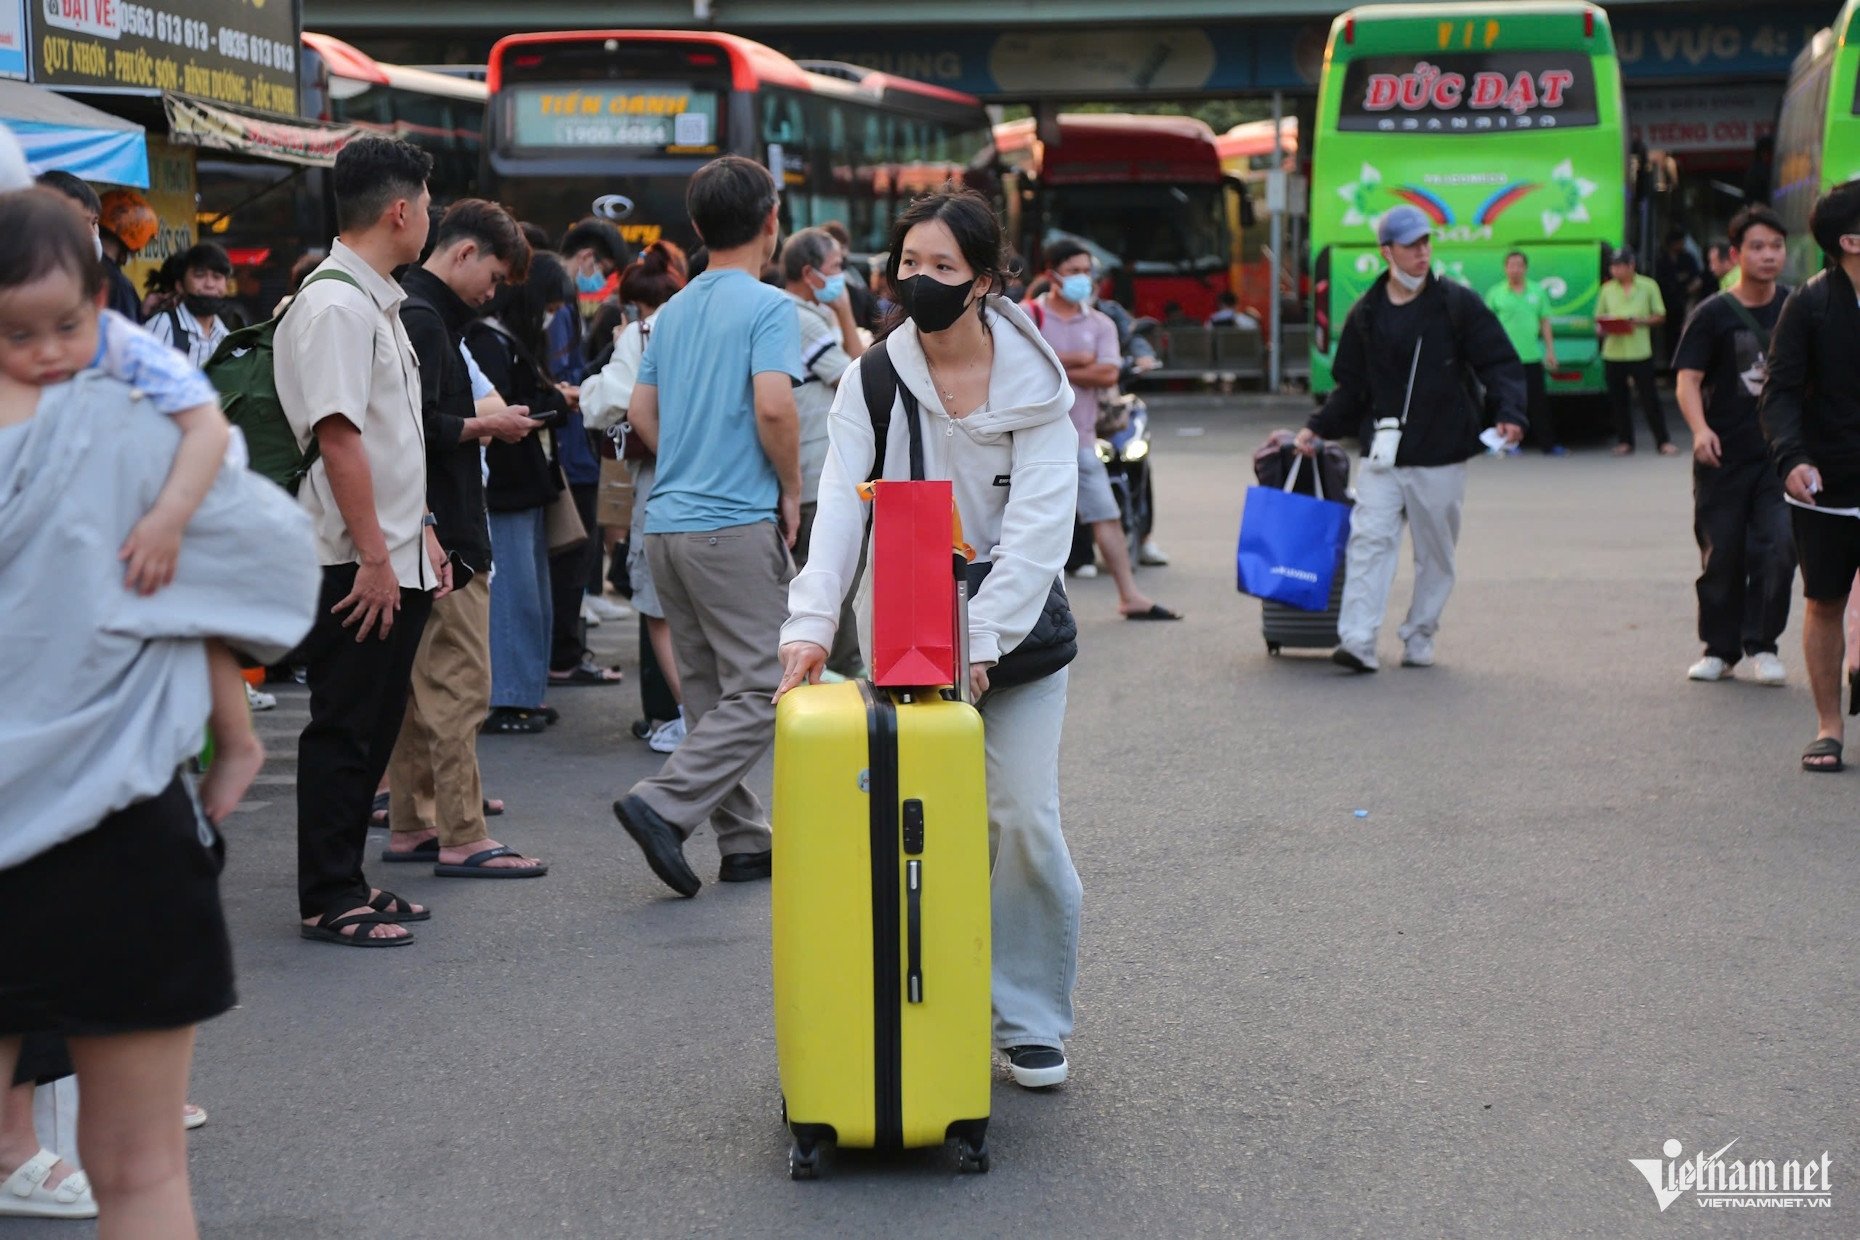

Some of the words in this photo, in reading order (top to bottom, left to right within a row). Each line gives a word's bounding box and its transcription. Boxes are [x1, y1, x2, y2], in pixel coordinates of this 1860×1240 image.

[157, 11, 181, 45] 613
[184, 18, 209, 52] 613
[1438, 19, 1500, 49] VIP
[43, 35, 69, 75] QUY
[72, 39, 107, 77] NHƠN
[540, 89, 602, 115] TIẾN
[1363, 61, 1466, 111] ĐỨC
[1468, 69, 1575, 115] ĐẠT
